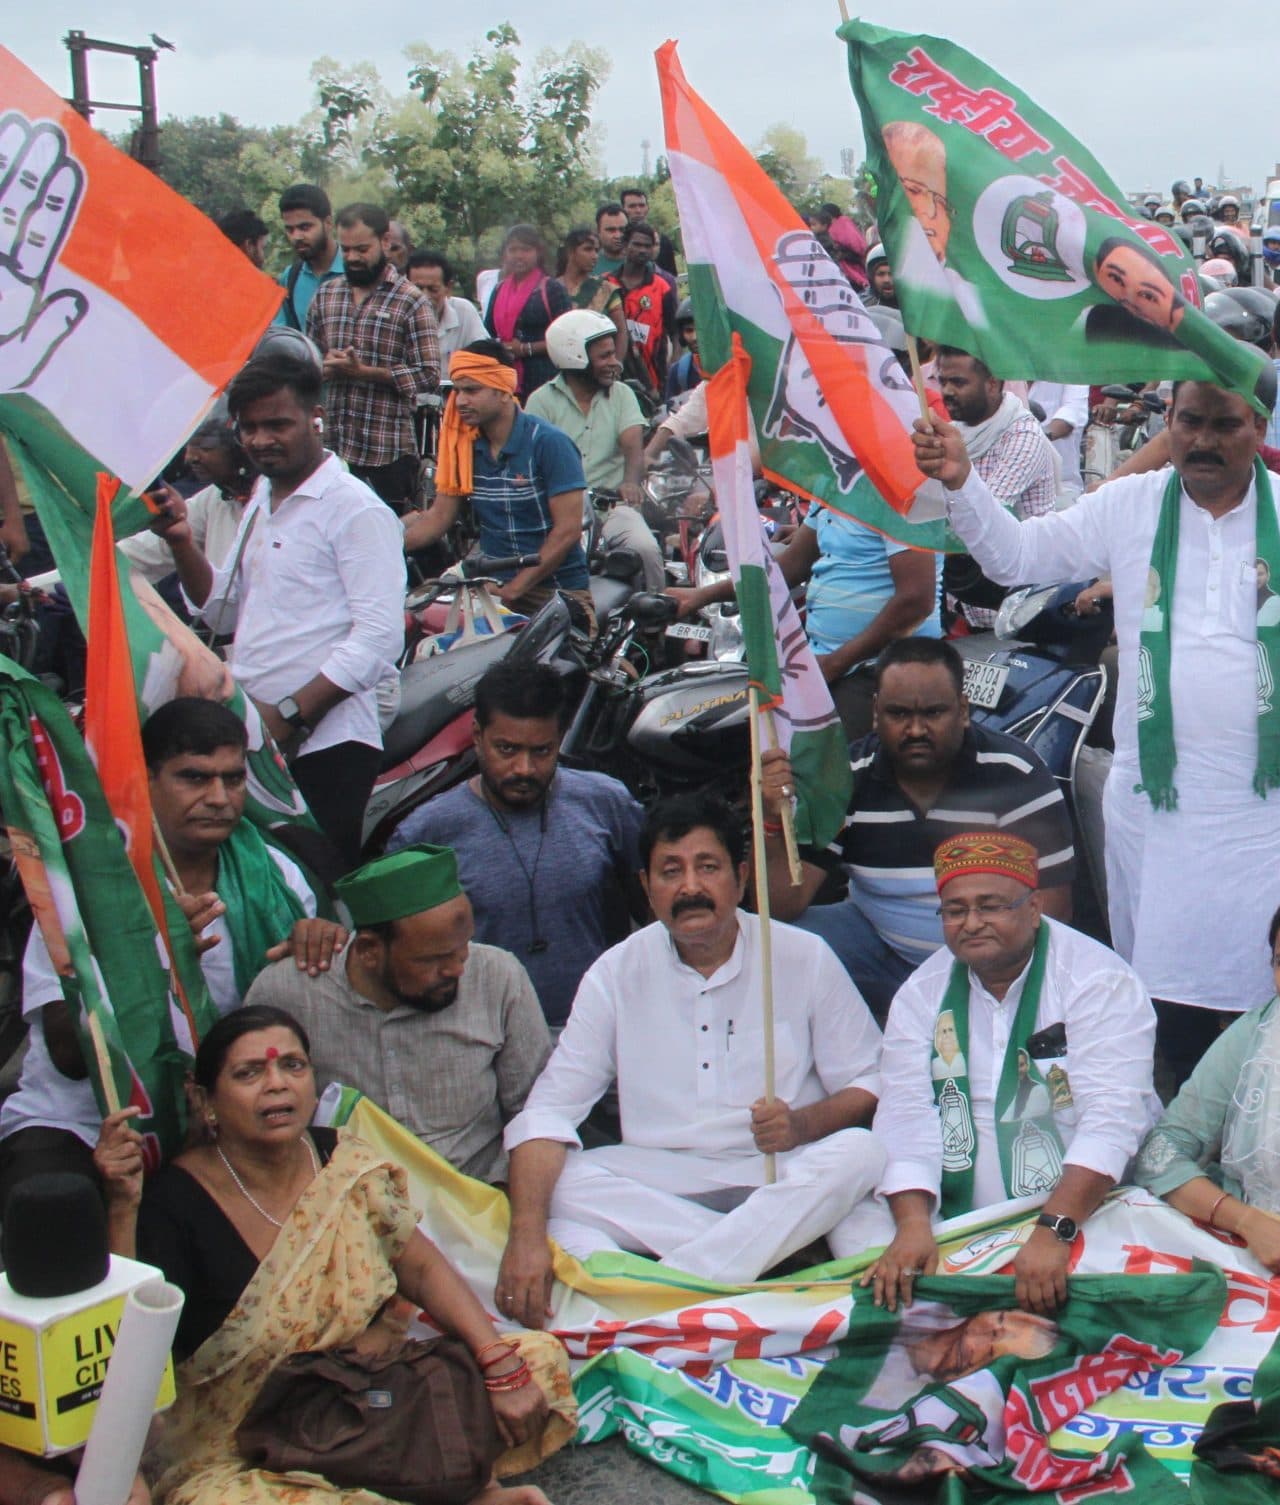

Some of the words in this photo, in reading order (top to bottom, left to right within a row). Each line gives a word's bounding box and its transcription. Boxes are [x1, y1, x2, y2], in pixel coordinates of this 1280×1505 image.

[889, 47, 1054, 161] राष्ट्रीय
[74, 1318, 122, 1363] LIV
[75, 1356, 111, 1387] CIT
